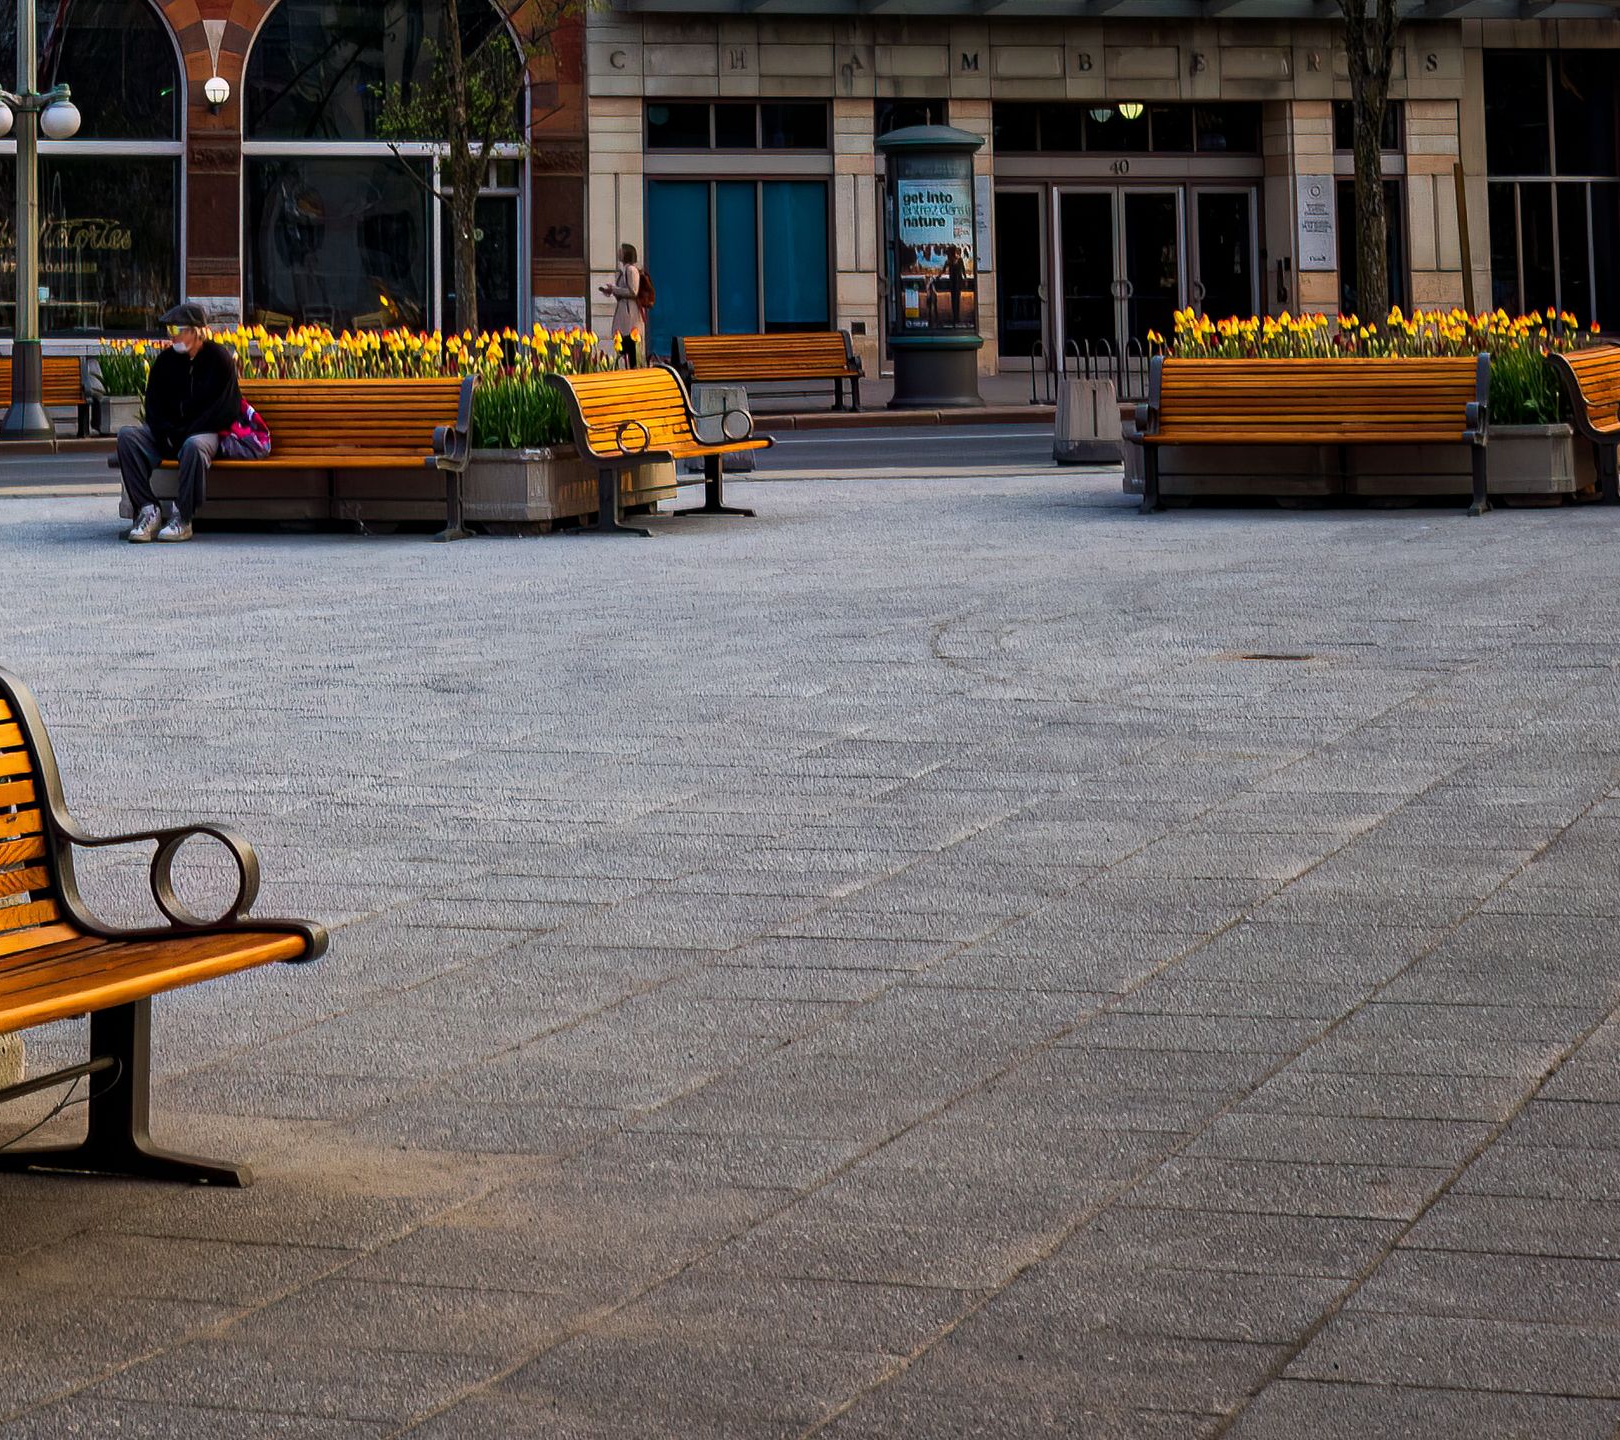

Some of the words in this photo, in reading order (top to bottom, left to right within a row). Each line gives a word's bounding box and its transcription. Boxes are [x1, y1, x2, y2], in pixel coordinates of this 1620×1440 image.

[1110, 159, 1129, 175] 40
[903, 191, 923, 205] get
[903, 216, 945, 228] nature
